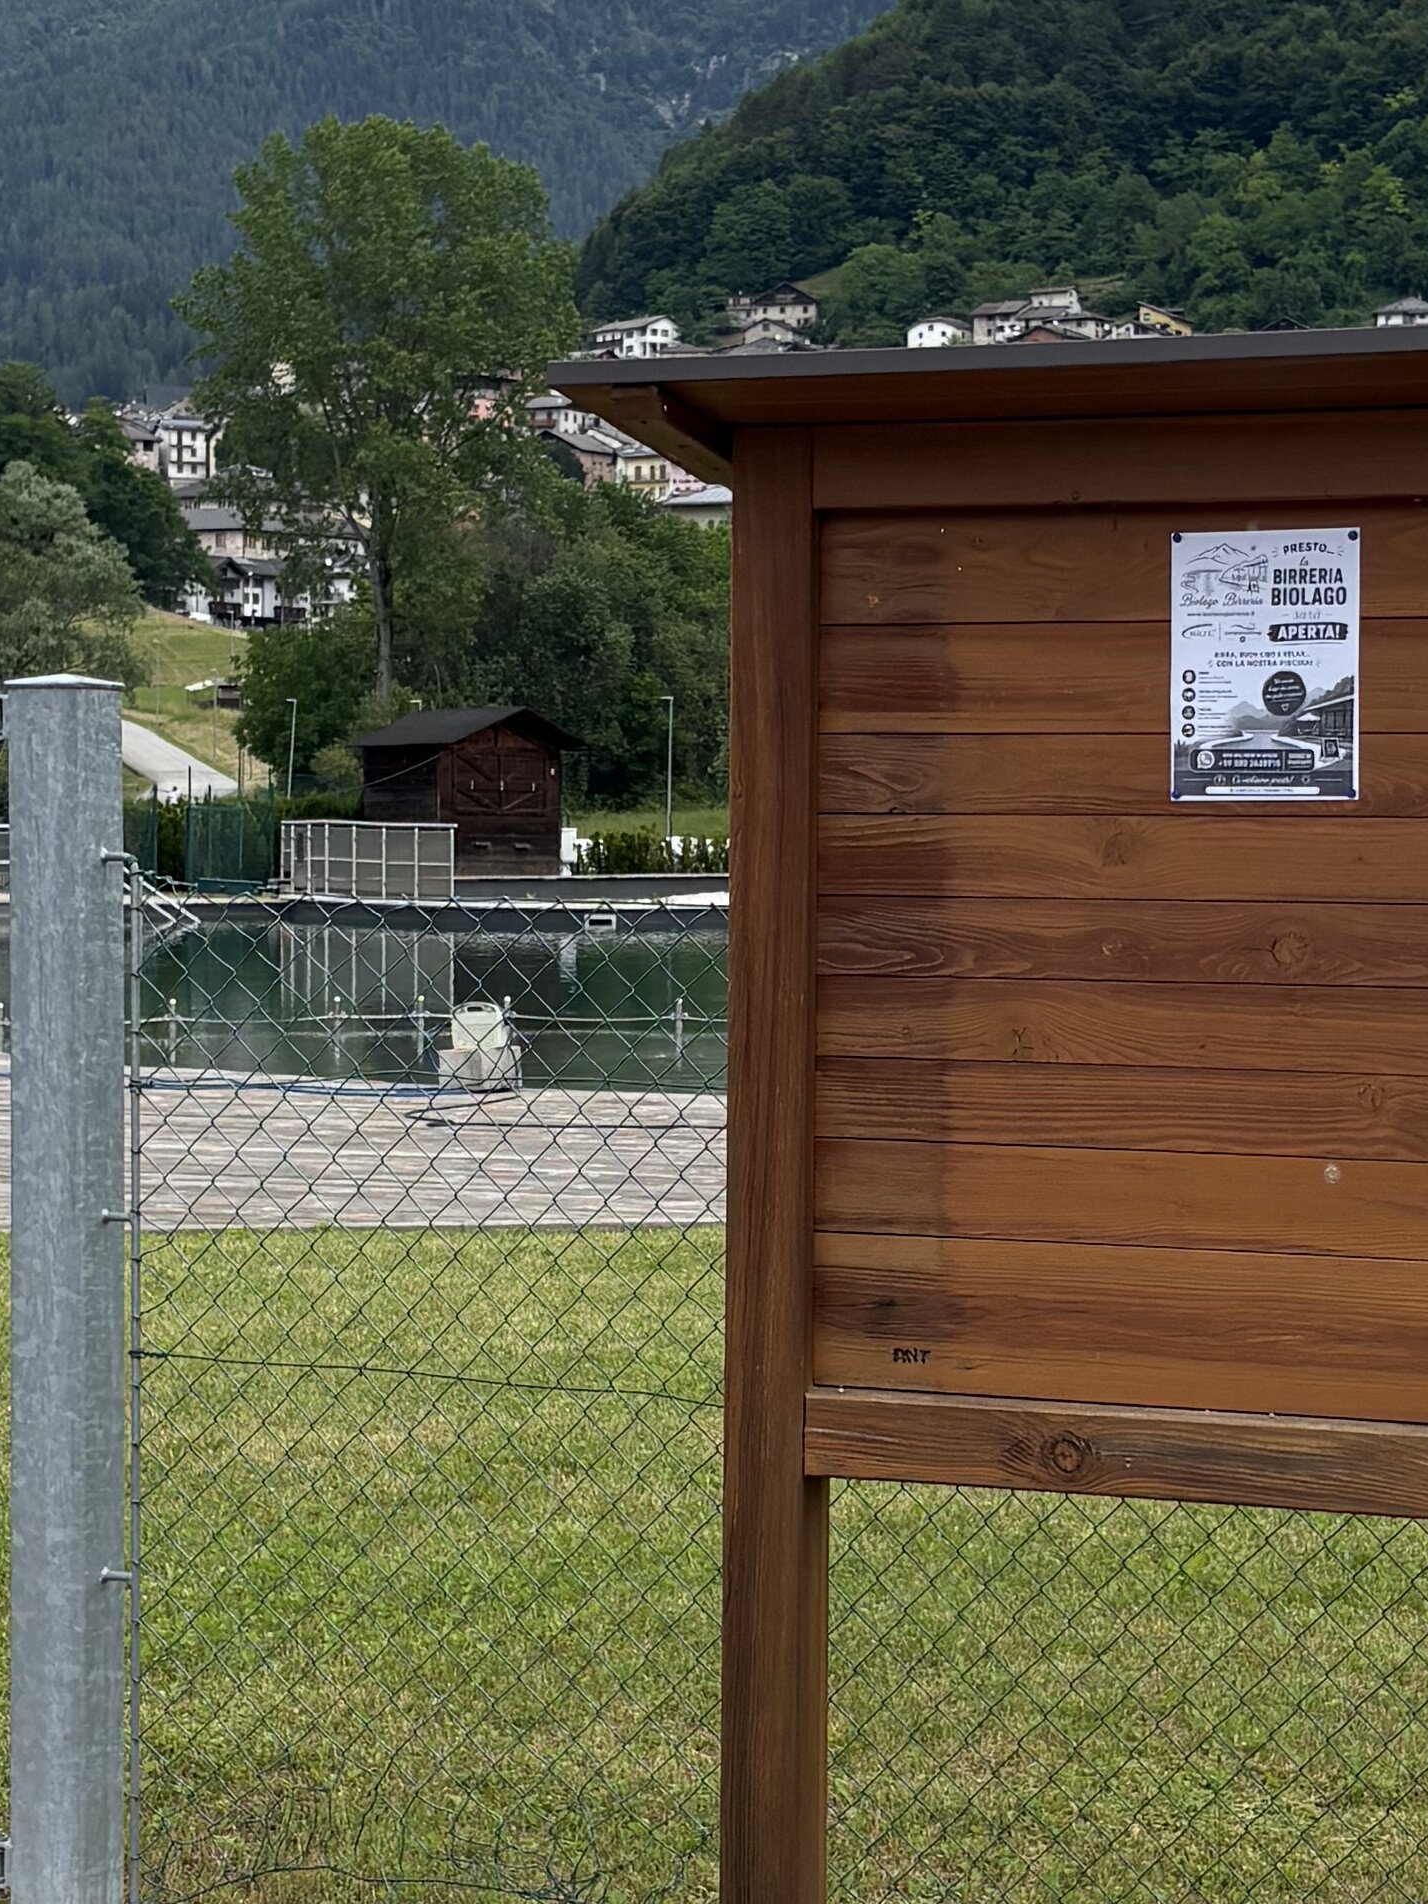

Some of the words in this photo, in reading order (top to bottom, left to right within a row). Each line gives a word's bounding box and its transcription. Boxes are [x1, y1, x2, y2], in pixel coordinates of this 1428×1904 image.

[1273, 568, 1343, 585] BIRRERIA
[1180, 593, 1219, 609] Biolago
[1223, 593, 1263, 607] Birreria
[1271, 586, 1347, 606] BIOLAGO
[1277, 624, 1340, 640] APERTA!
